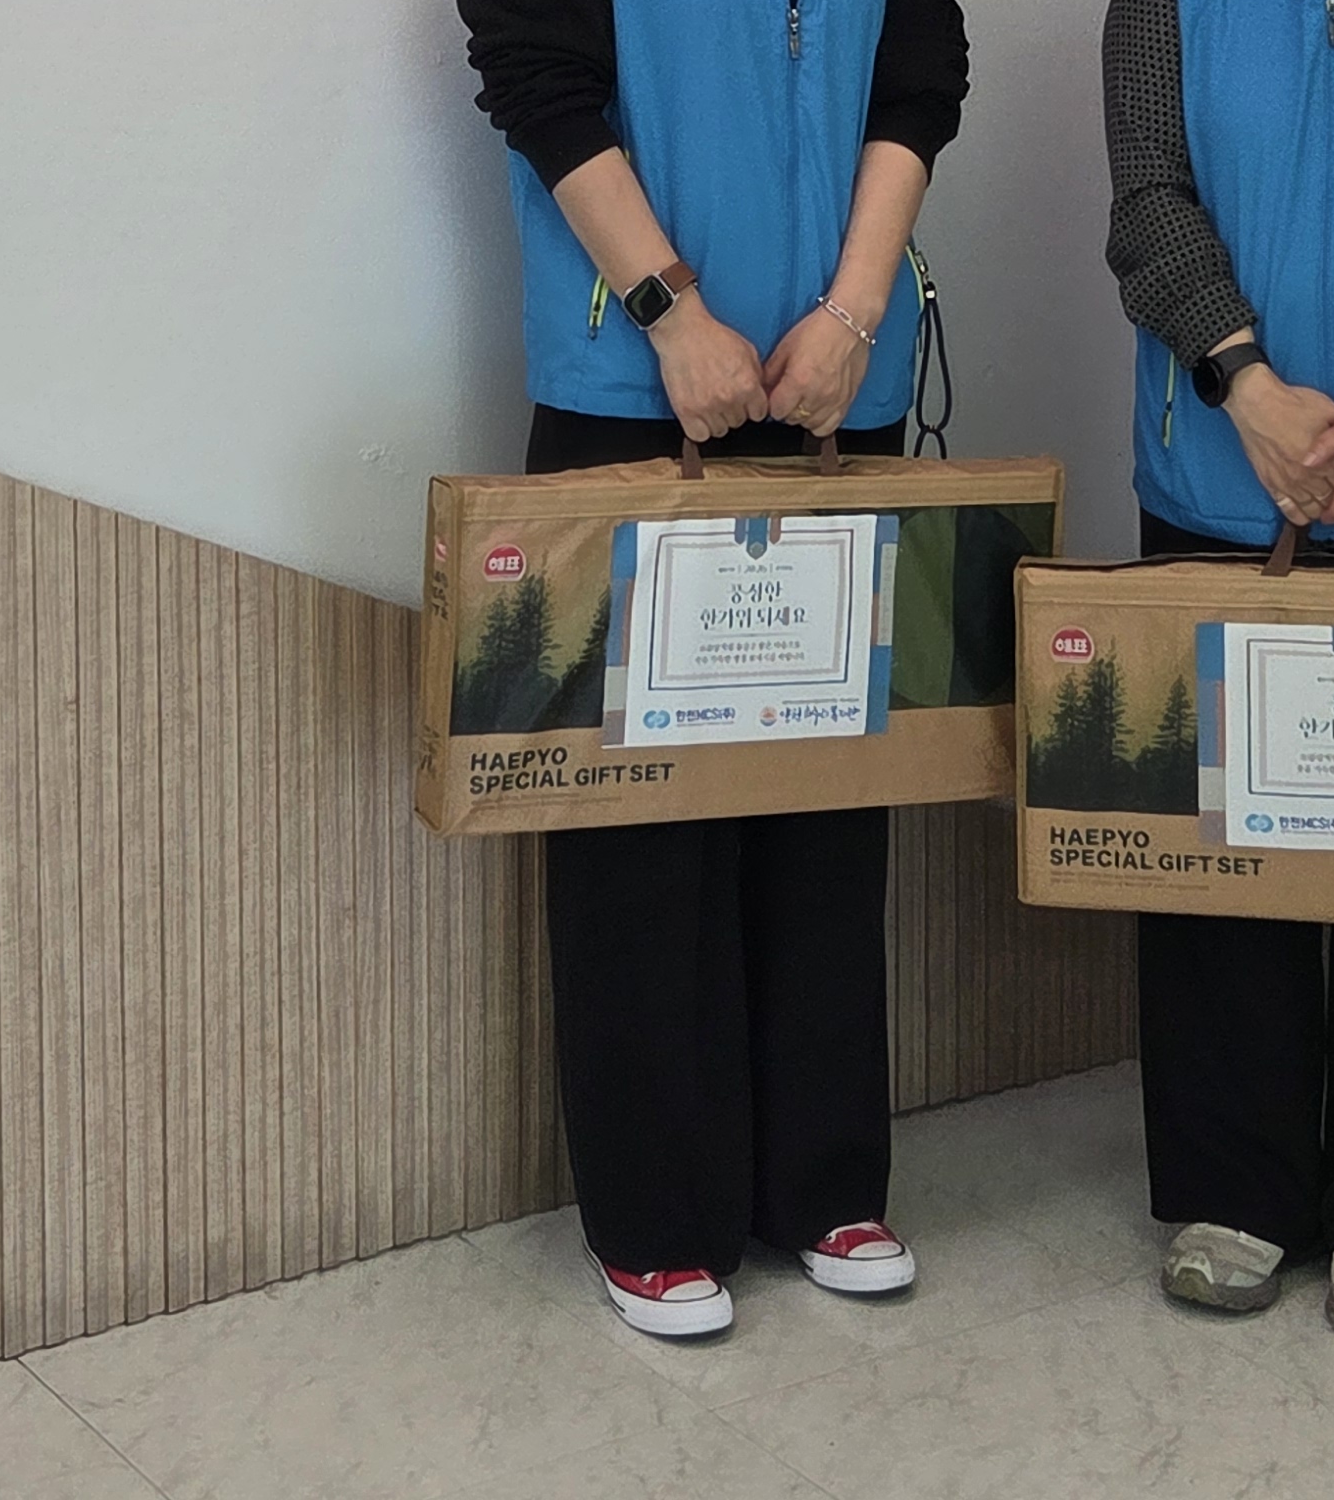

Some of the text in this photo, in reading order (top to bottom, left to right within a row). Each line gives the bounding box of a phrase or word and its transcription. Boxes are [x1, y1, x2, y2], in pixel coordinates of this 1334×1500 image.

[488, 555, 521, 572] 해표
[1055, 637, 1088, 654] 해표
[470, 747, 568, 771] HAEPYO
[469, 763, 676, 795] SPECIAL GIFT SET
[1049, 825, 1150, 849] HAEPYO
[1049, 847, 1265, 877] SPECIAL GIFT SET
